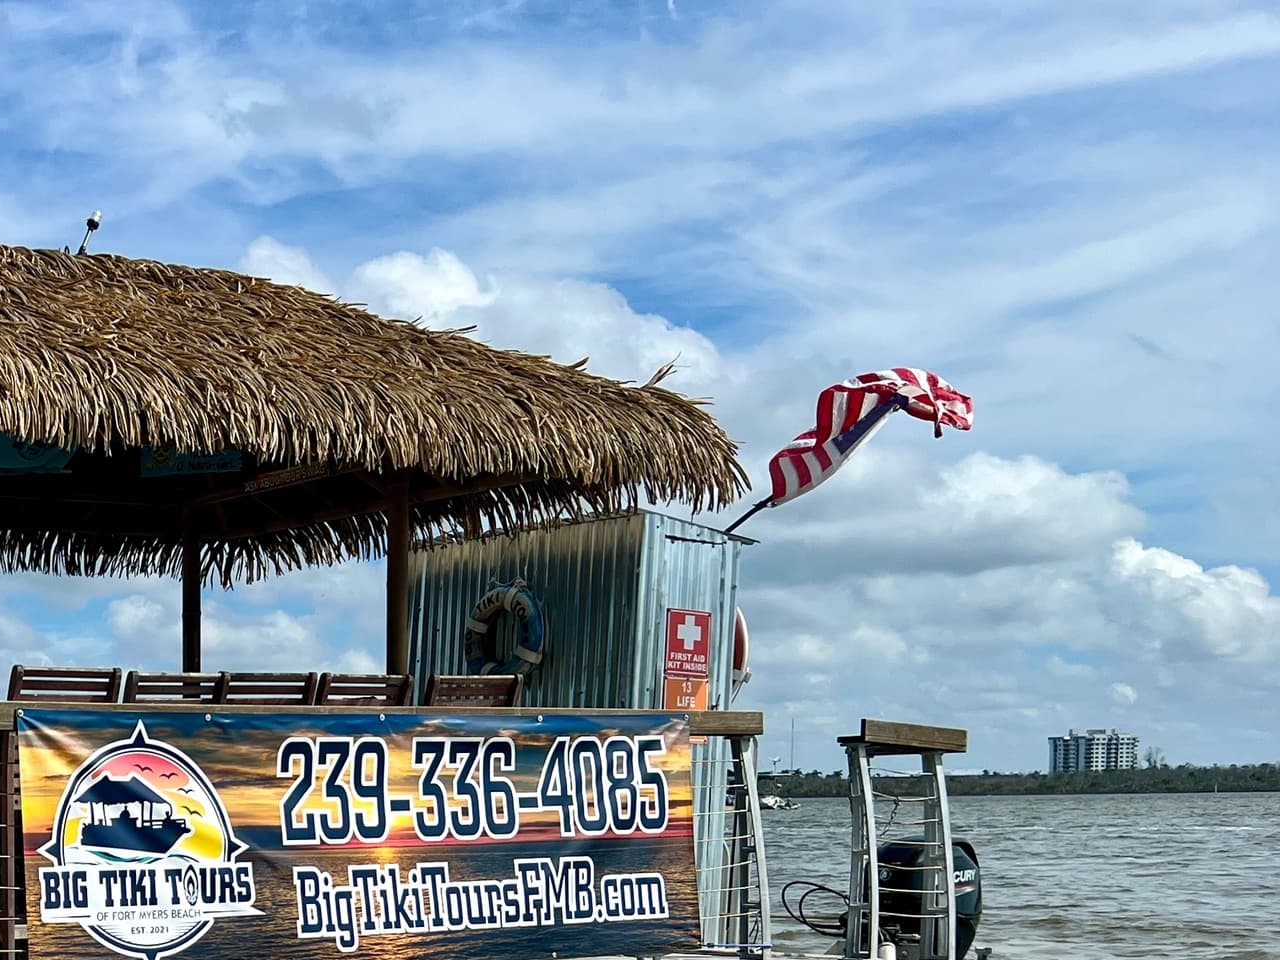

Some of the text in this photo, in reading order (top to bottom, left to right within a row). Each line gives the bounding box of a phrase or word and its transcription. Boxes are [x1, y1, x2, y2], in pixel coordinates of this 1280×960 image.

[476, 592, 500, 613] TIKI
[670, 652, 705, 662] FIRST AID
[668, 661, 707, 671] KIT INSIDE
[681, 682, 692, 693] 13
[677, 696, 696, 708] LIFE
[278, 736, 668, 844] 239-336-4085
[953, 869, 976, 883] CURY
[43, 864, 252, 909] BIG TIKI TOURS
[295, 857, 667, 950] BigTikiToursFMB.com
[96, 908, 201, 922] OF FORT MYERS BEACH
[131, 925, 169, 935] EST. 2021
